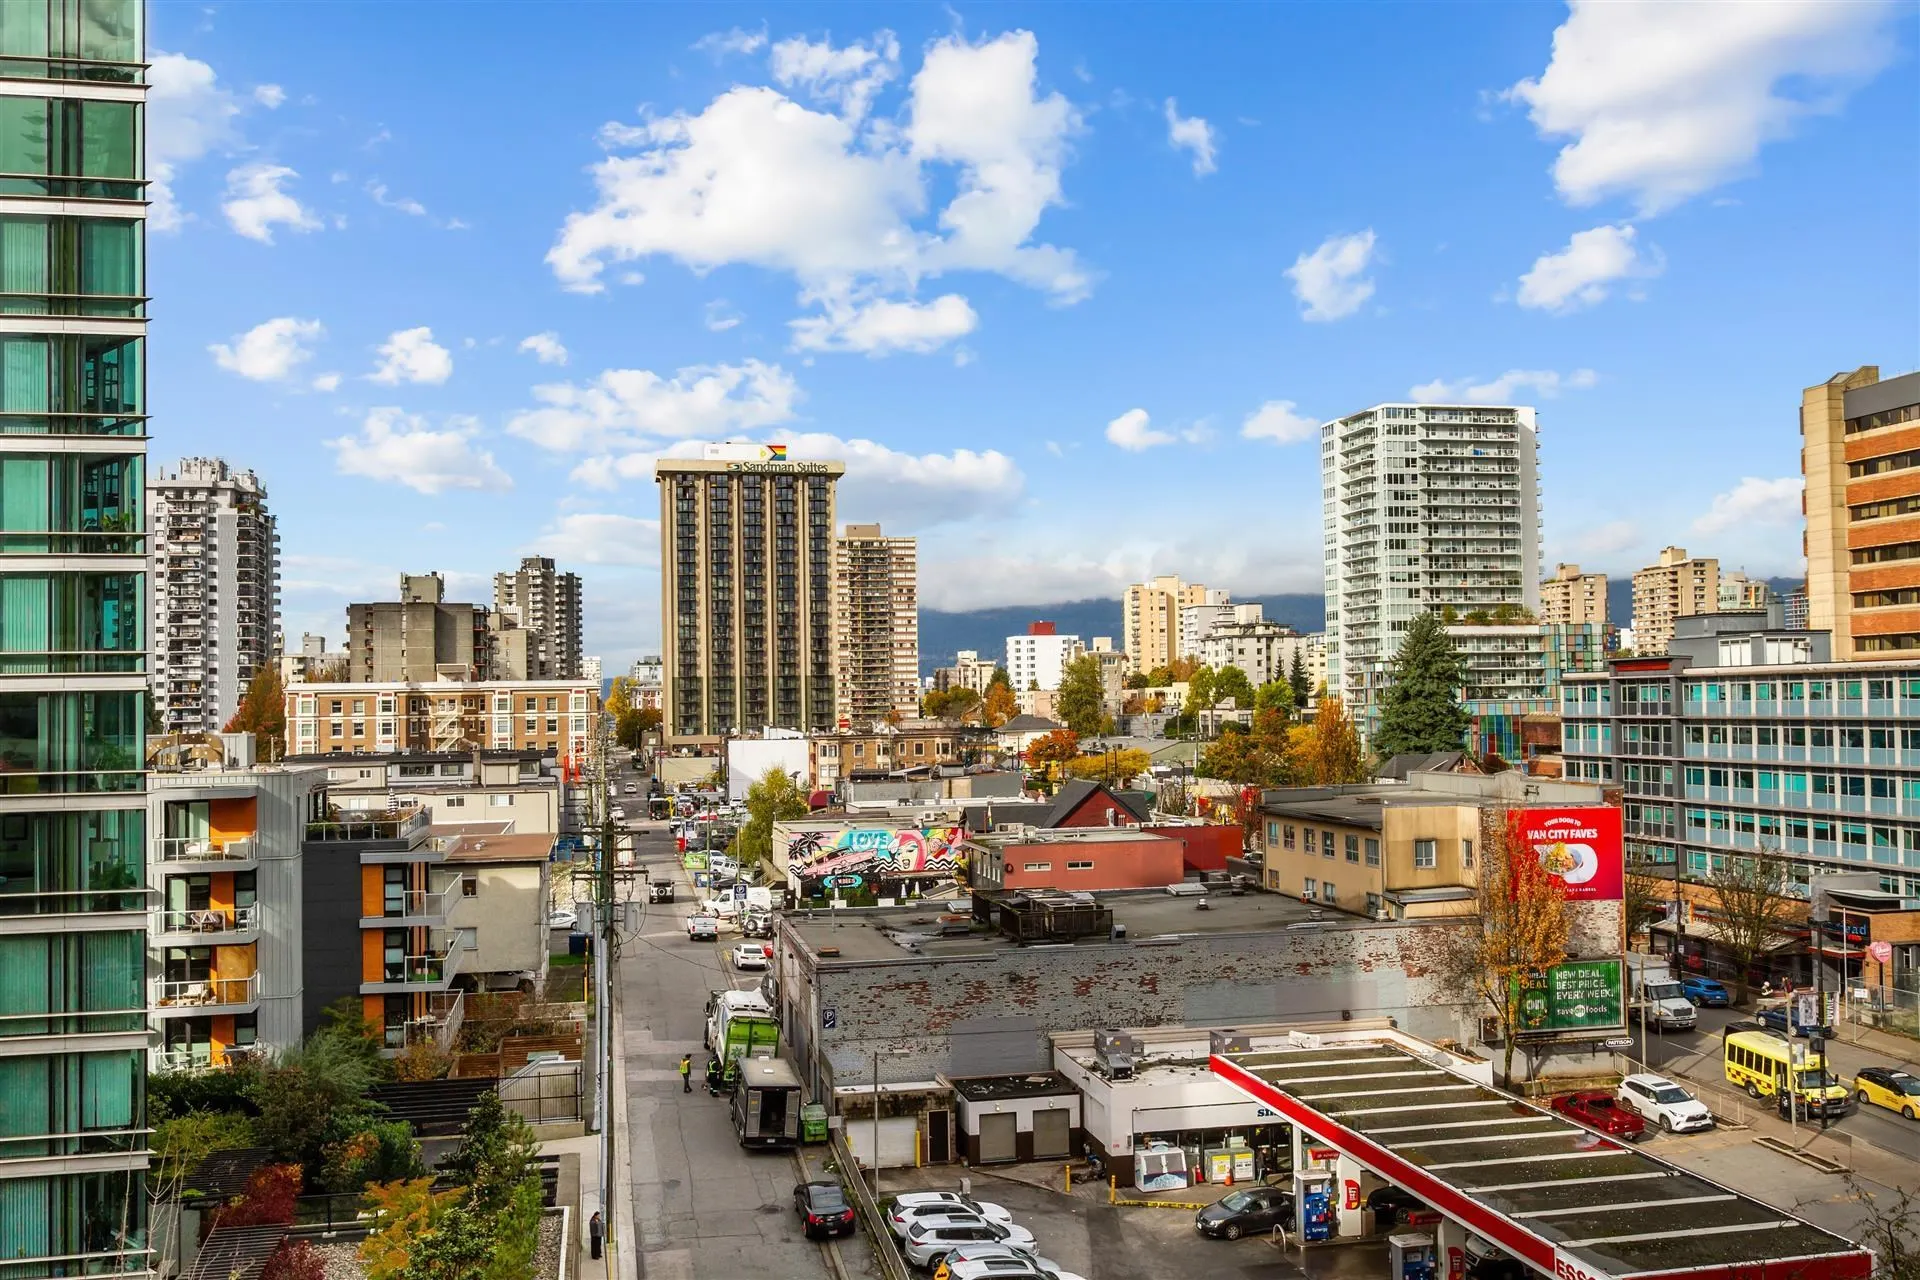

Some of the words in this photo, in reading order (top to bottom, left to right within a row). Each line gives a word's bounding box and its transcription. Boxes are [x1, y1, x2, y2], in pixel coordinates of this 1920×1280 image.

[743, 461, 795, 473] Sandman
[797, 462, 828, 473] Suites
[1544, 818, 1558, 827] YOUR
[1574, 819, 1581, 827] TO
[848, 832, 888, 846] LOVE
[1527, 830, 1546, 839] VAN
[1548, 829, 1569, 839] CITY
[1570, 828, 1598, 838] FAVES
[1556, 970, 1576, 980] NEW
[1578, 969, 1605, 979] DEAL.
[1556, 981, 1577, 990] BEST
[1578, 979, 1607, 989] PRICE.
[1556, 990, 1585, 1000] EVERY
[1587, 989, 1614, 998] WEEK.
[1585, 1004, 1608, 1014] foods
[826, 1011, 833, 1019] P
